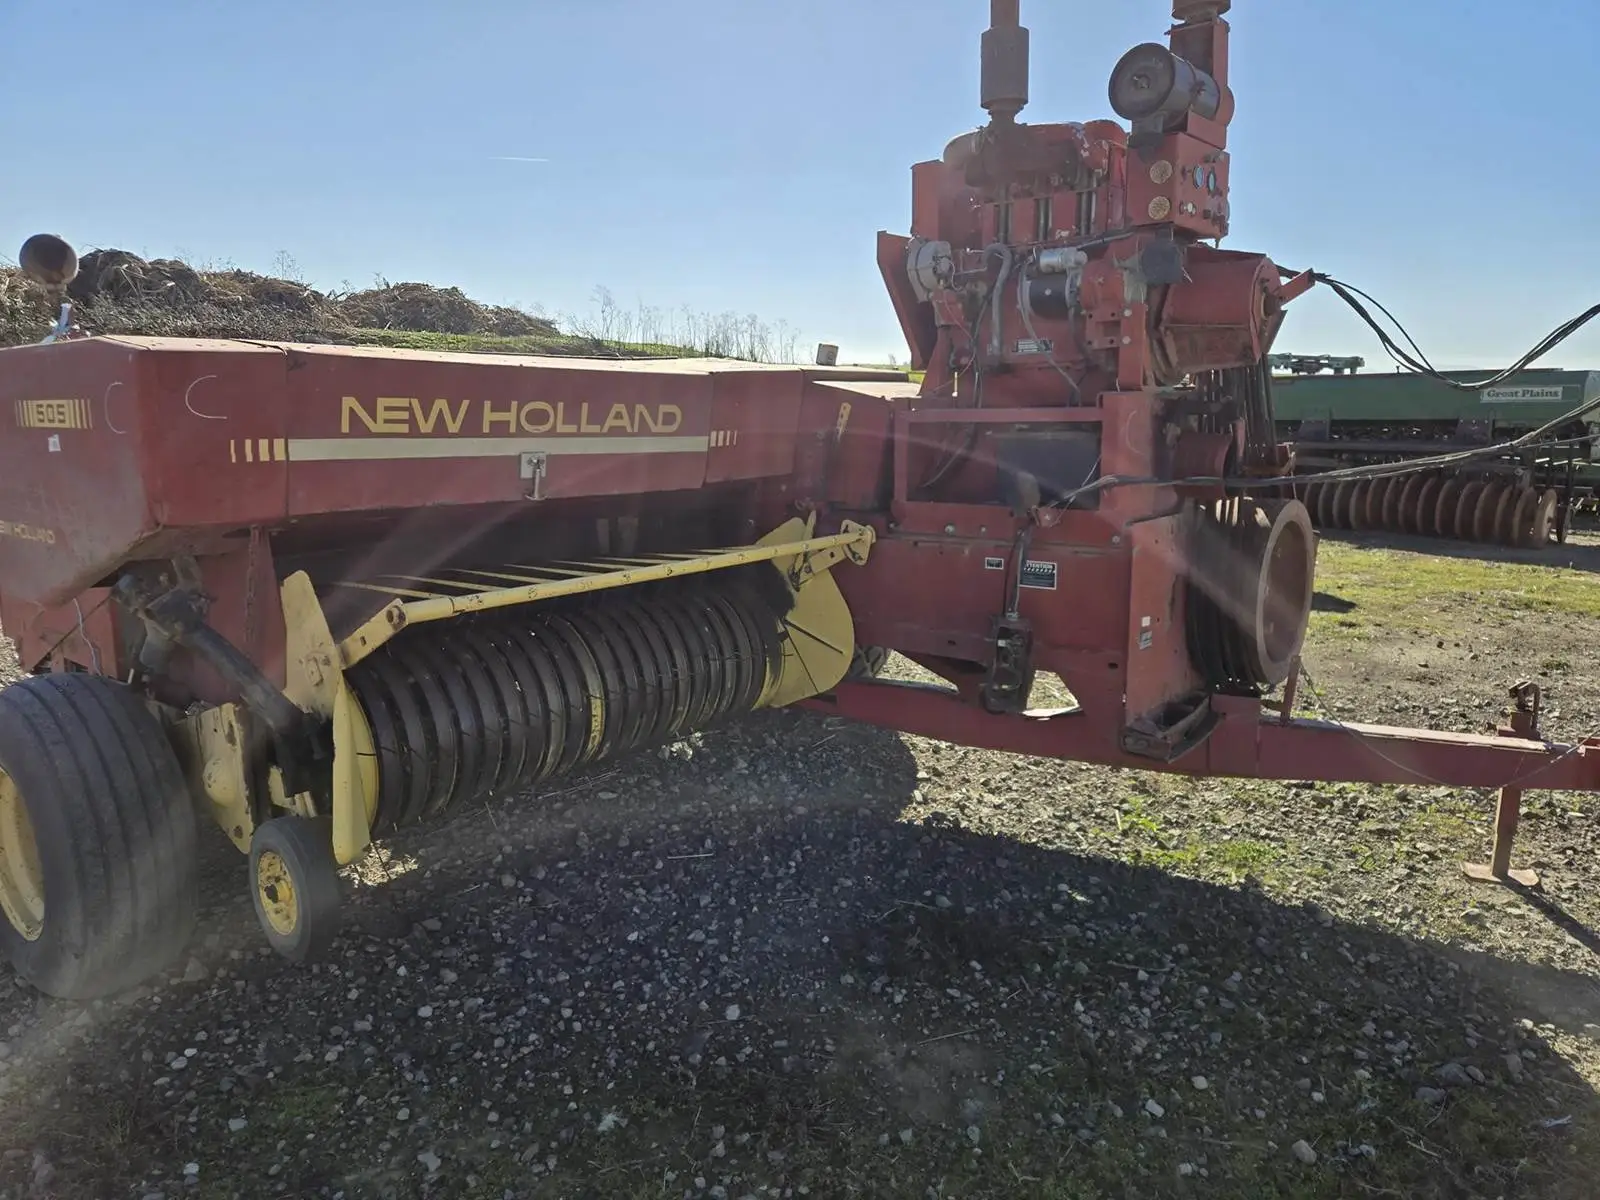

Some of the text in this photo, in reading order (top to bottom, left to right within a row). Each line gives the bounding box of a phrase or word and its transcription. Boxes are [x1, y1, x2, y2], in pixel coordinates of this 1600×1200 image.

[1487, 388, 1560, 398] Great Plains
[36, 403, 66, 424] 505
[340, 396, 682, 434] NEW HOLLAND
